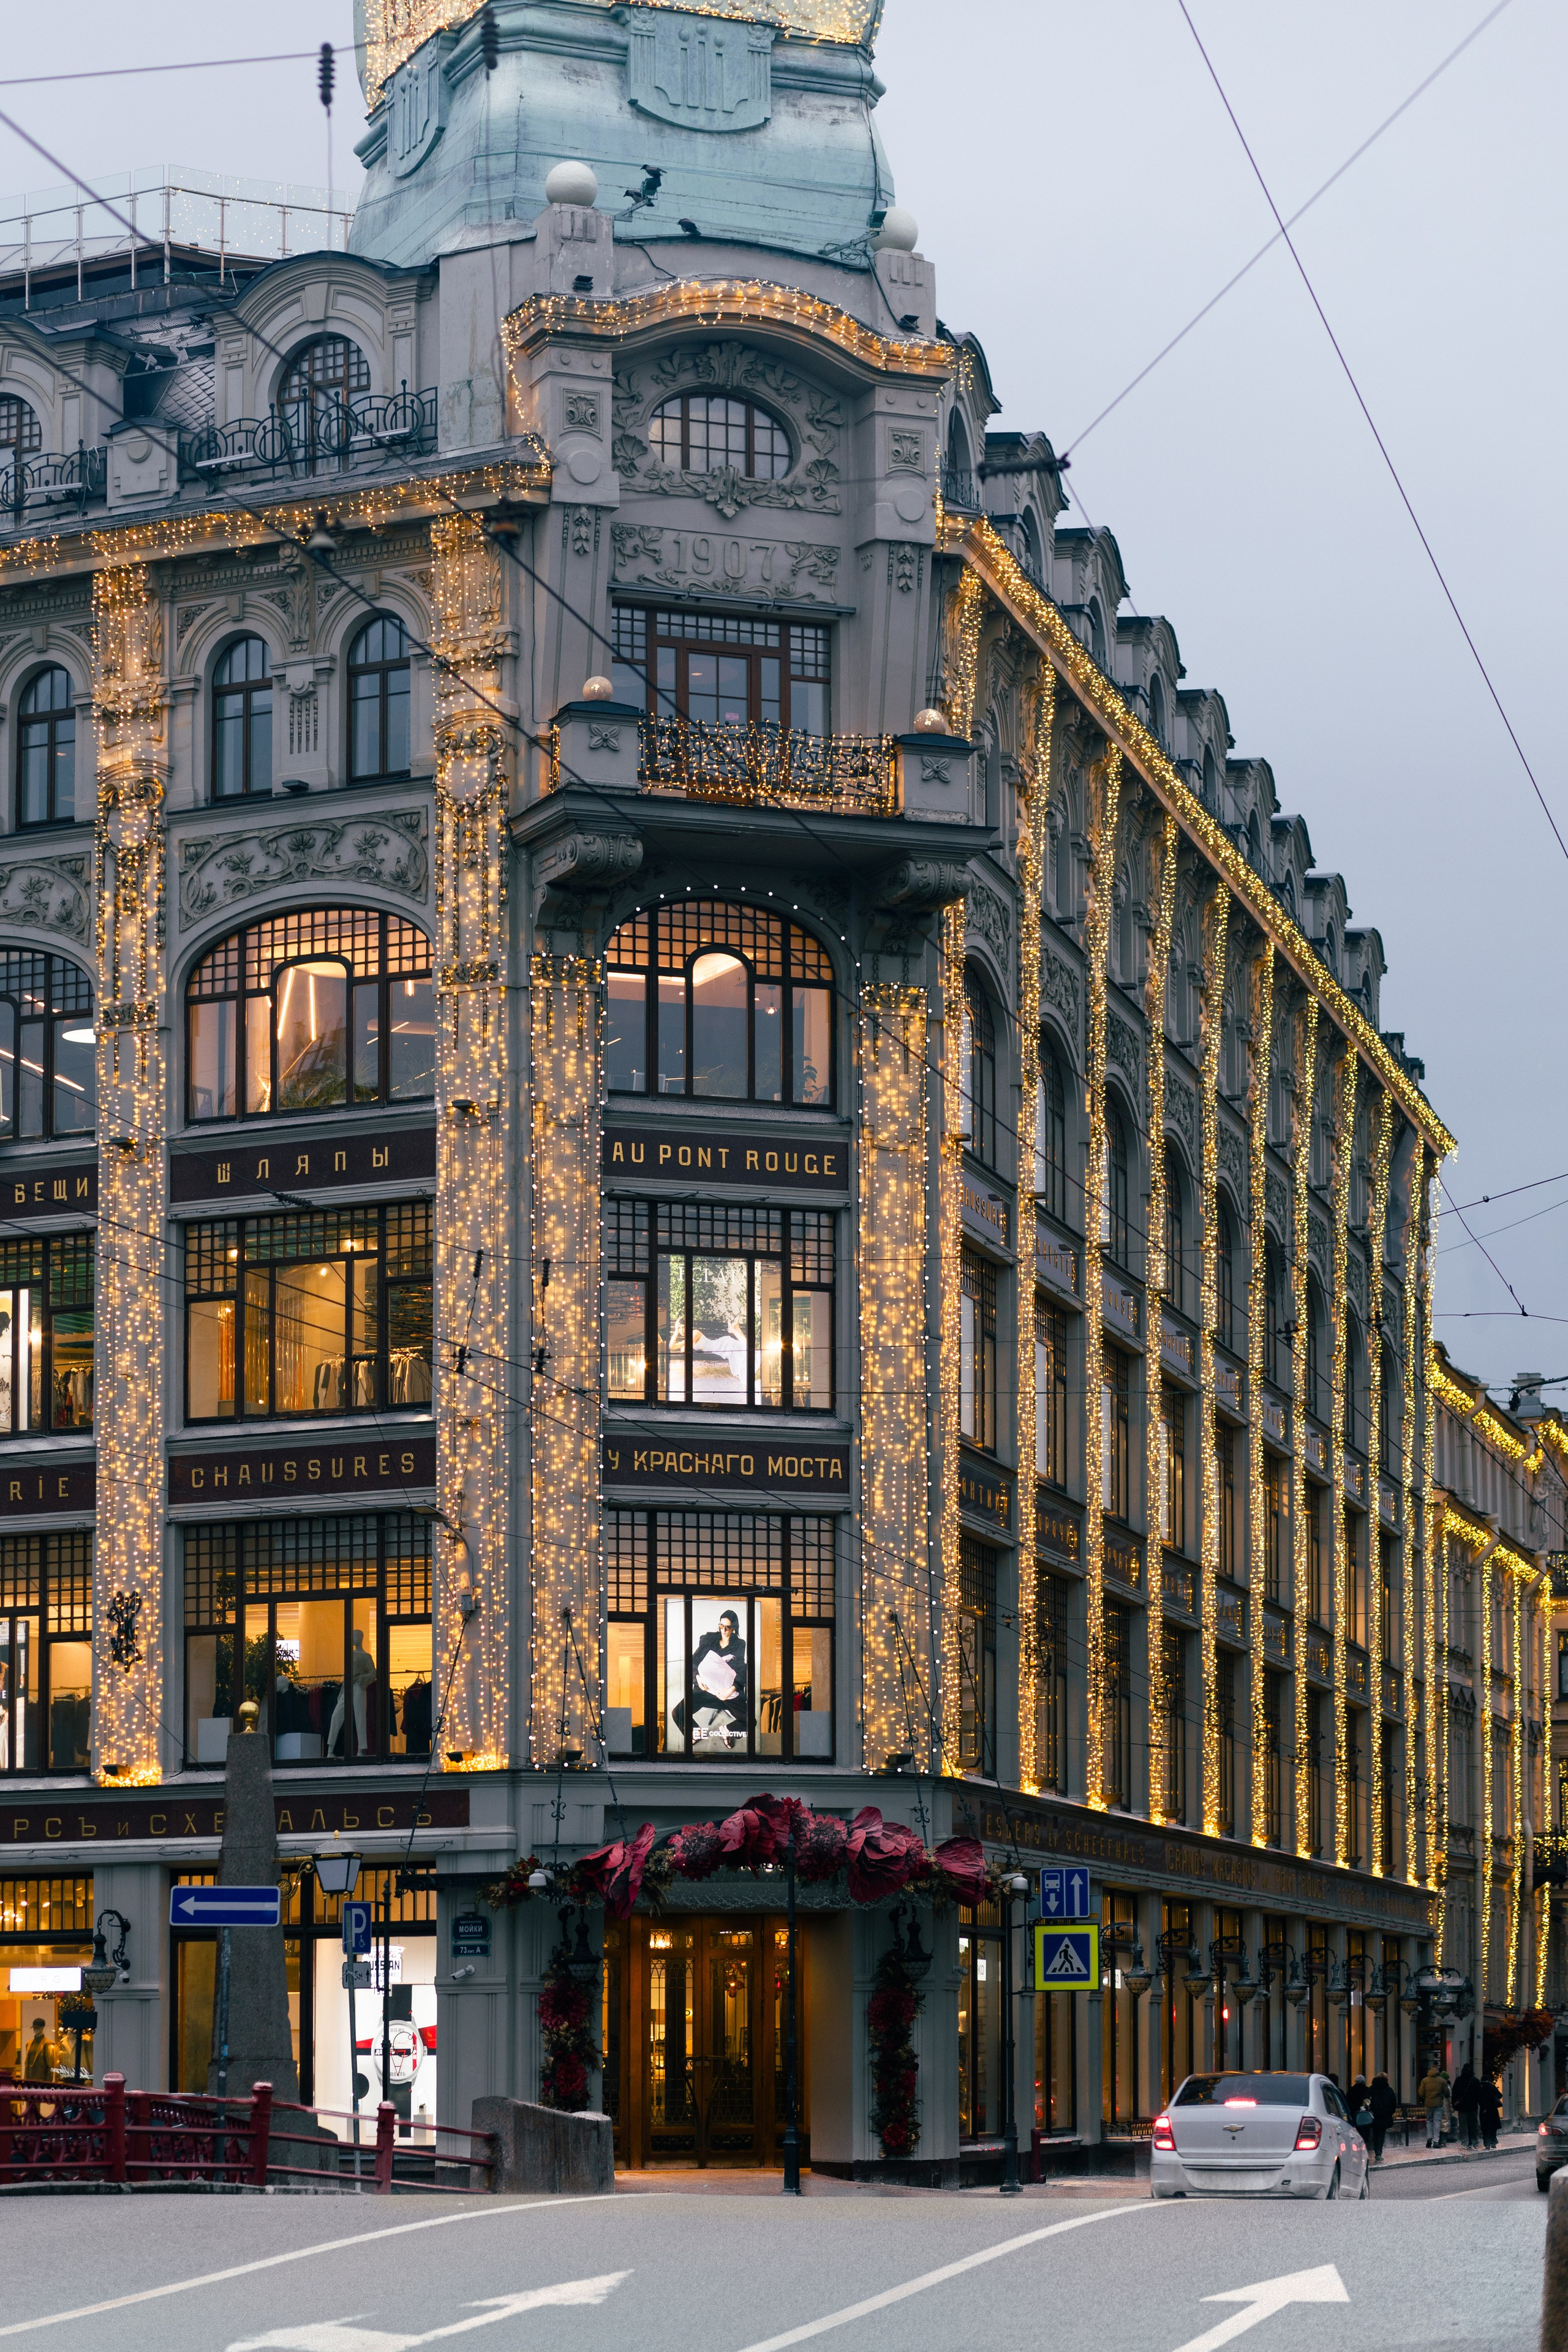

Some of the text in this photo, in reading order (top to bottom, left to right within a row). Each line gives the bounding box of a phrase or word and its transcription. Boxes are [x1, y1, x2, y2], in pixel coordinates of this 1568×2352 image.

[673, 532, 776, 581] 1907
[217, 1146, 388, 1183] ШЛЯПЫ
[612, 1142, 837, 1175] AU PONT ROUGE
[14, 1177, 88, 1204] ВЕЩИ
[191, 1452, 415, 1489] CHAUSSURES
[608, 1450, 843, 1479] У КРАСНАГО МОСТА
[352, 1908, 367, 1948] P
[459, 1924, 483, 1932] МОЙКИ
